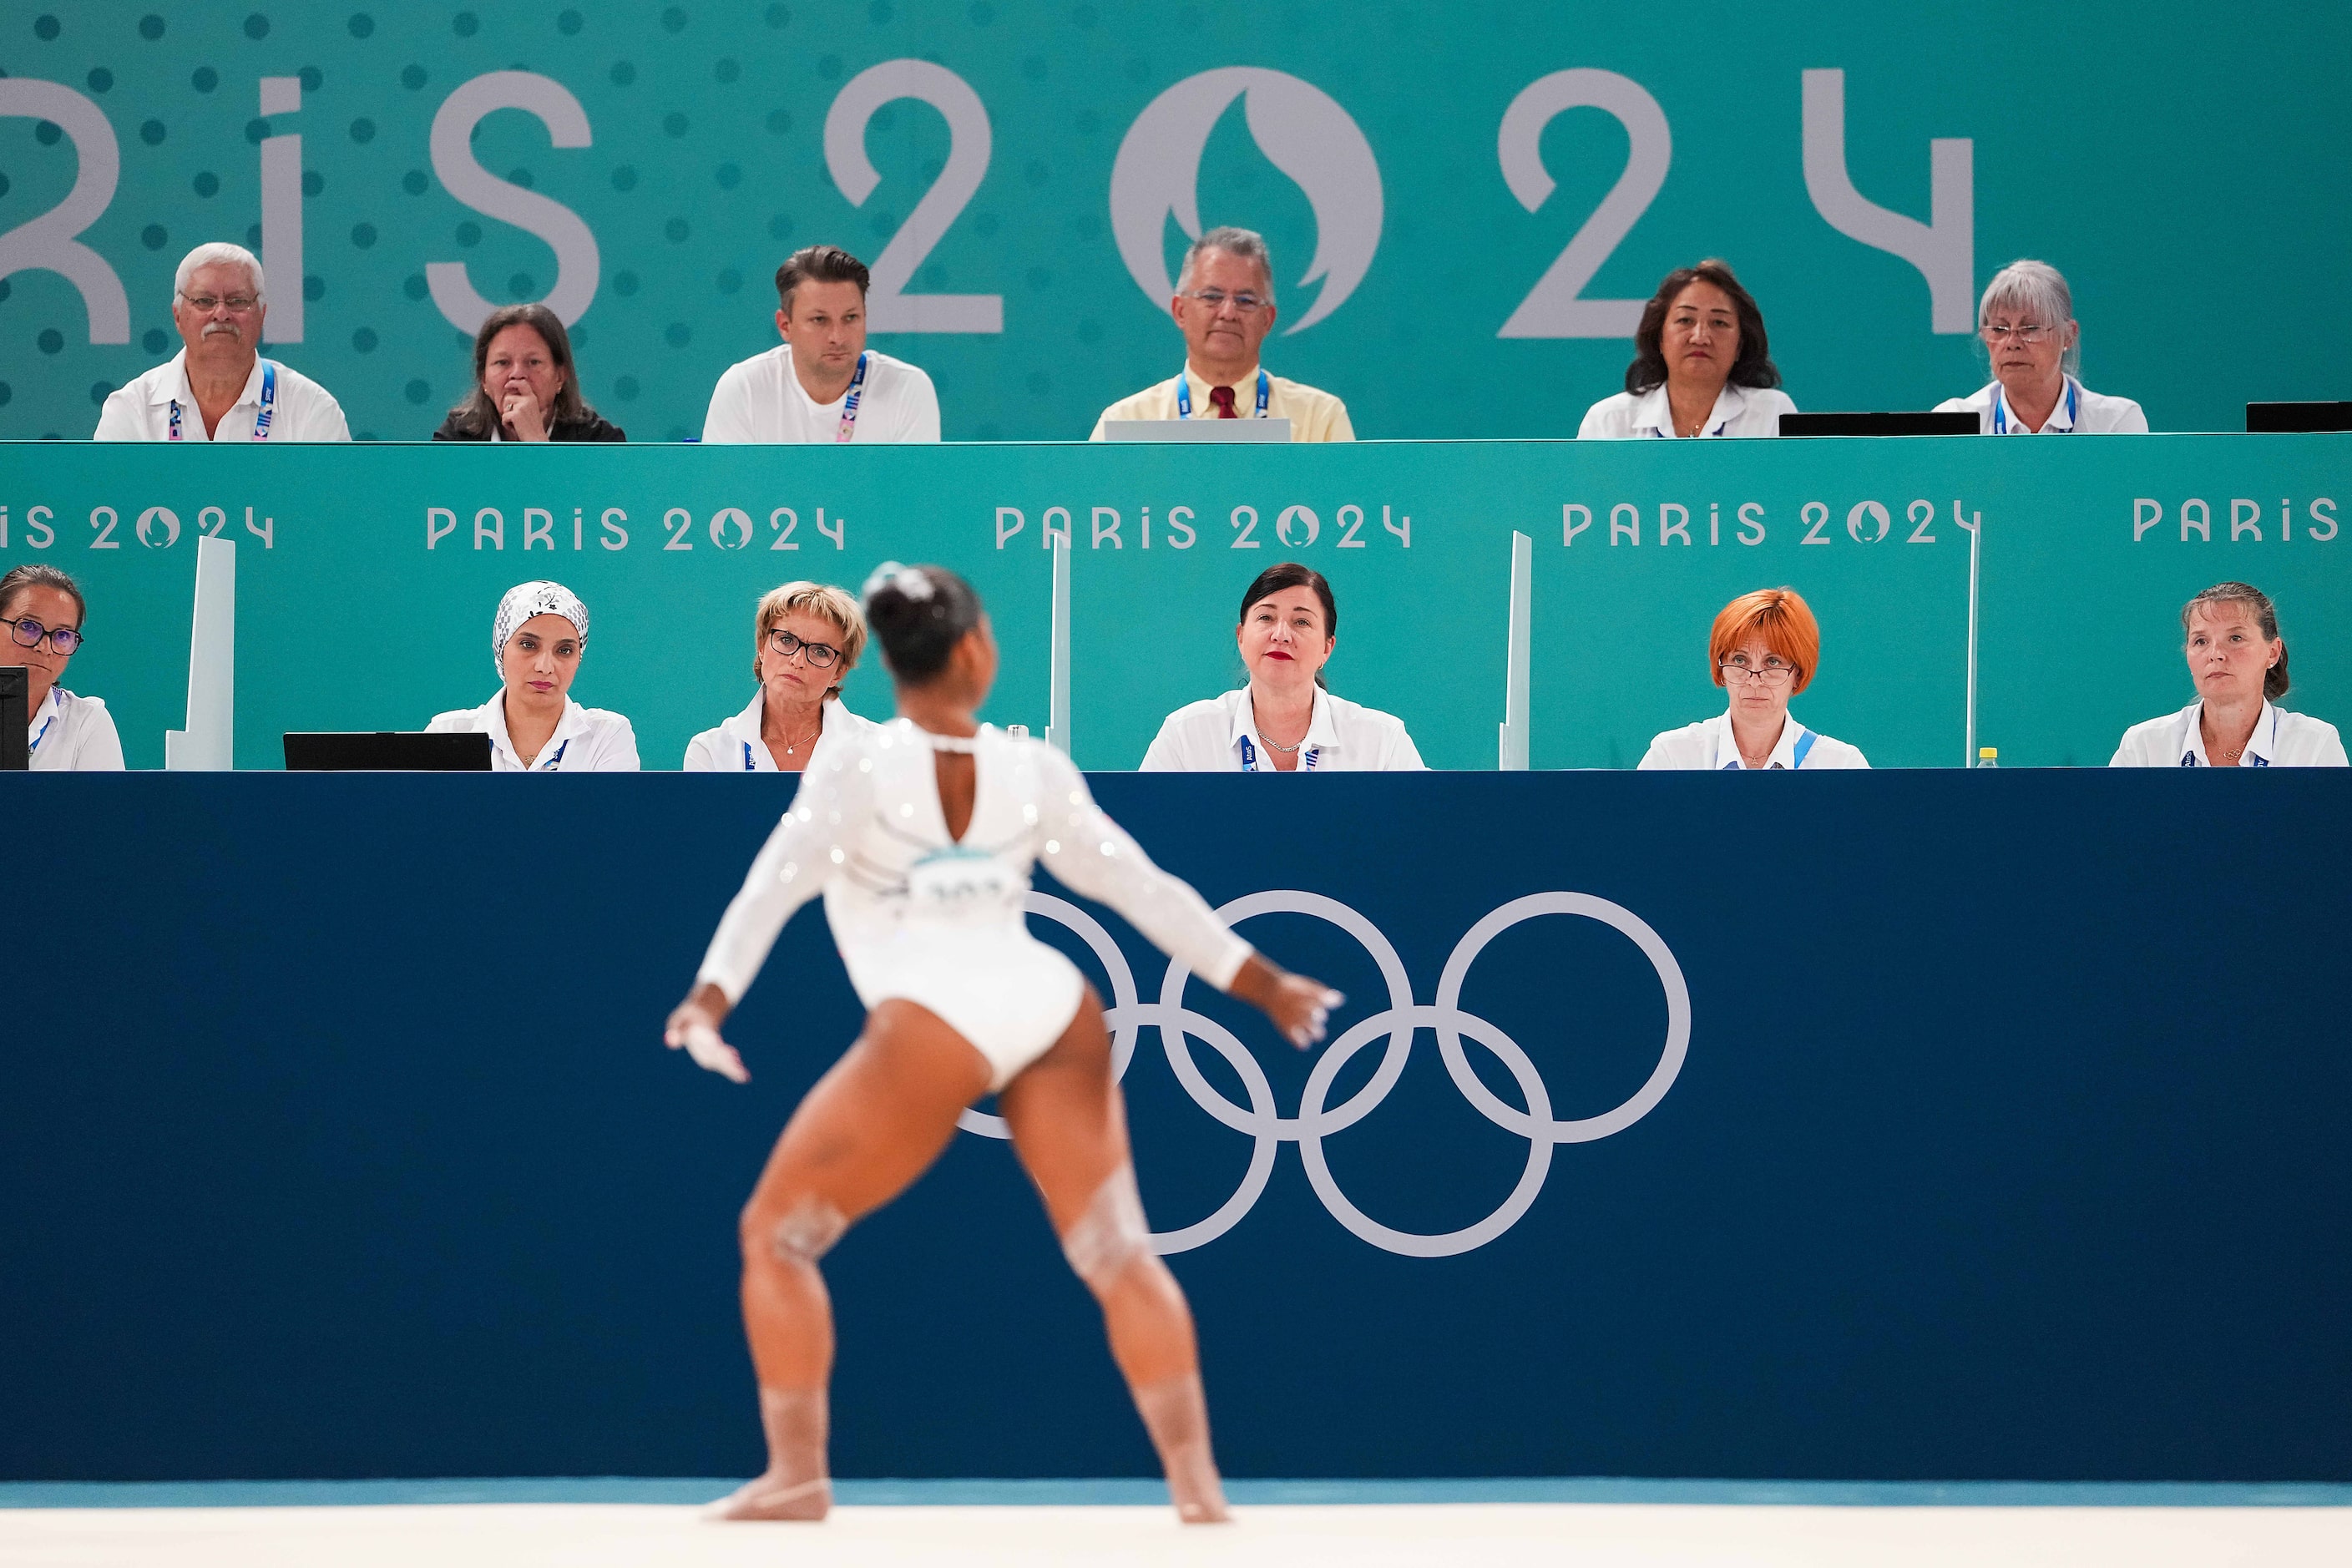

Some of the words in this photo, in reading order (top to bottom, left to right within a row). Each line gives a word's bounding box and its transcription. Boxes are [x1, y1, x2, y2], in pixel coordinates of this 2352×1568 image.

[665, 508, 844, 550] 2024
[1231, 505, 1410, 548] 2024
[1801, 499, 1981, 544] 2024
